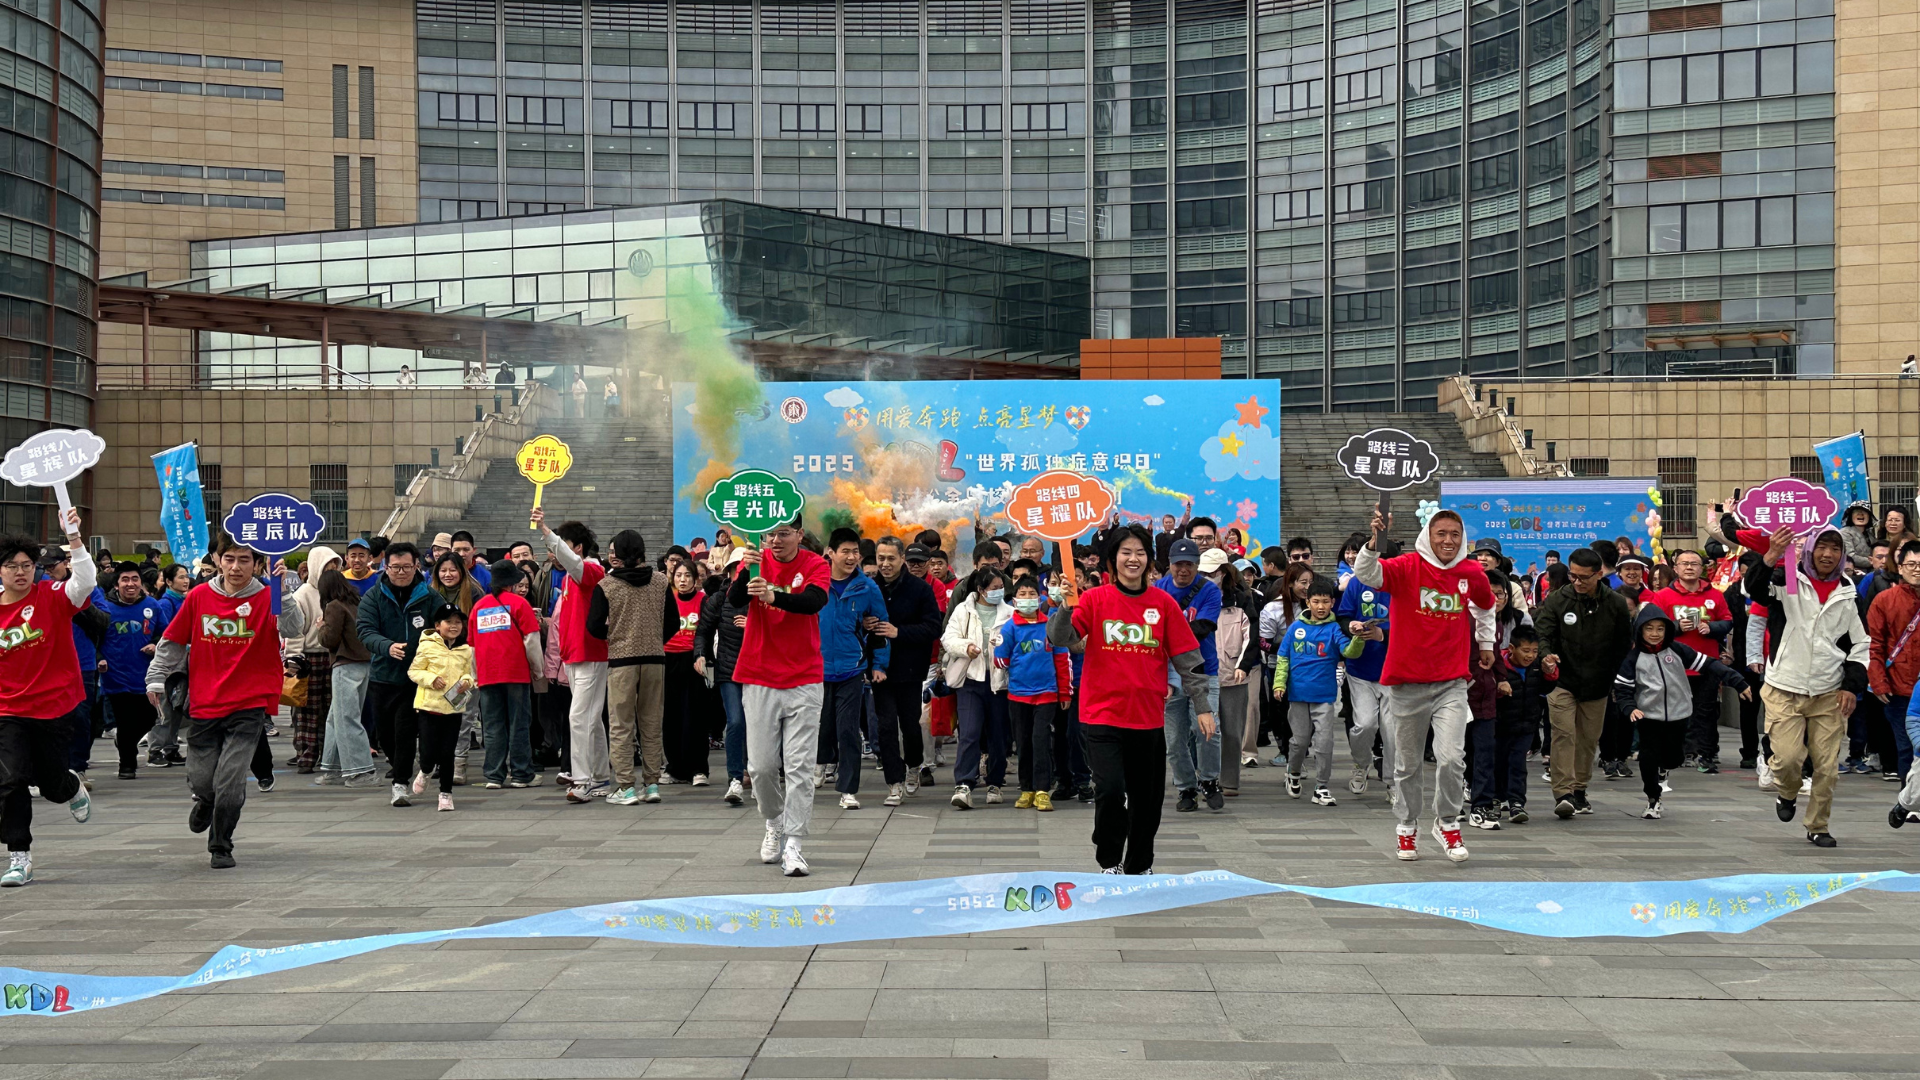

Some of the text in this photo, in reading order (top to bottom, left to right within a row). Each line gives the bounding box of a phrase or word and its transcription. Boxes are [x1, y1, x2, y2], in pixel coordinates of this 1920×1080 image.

[876, 404, 1059, 429] 用爱奔跑 点亮星梦
[28, 439, 71, 458] 路线八
[1368, 441, 1410, 456] 路线三
[20, 448, 88, 479] 星辉队
[525, 458, 559, 473] 星梦队
[793, 455, 854, 473] 2025
[1354, 456, 1420, 478] 星愿队
[734, 484, 775, 497] 路线五
[1036, 485, 1080, 502] 路线四
[1766, 491, 1808, 504] 路线二
[253, 506, 296, 520] 路线七
[723, 500, 787, 518] 星光队
[1027, 501, 1096, 527] 星耀队
[1755, 507, 1820, 524] 星语队
[241, 522, 309, 541] 星辰队
[1419, 586, 1464, 613] KDL
[1361, 603, 1389, 618] KD
[115, 619, 151, 635] KDL
[201, 614, 255, 638] KDL
[1103, 619, 1159, 647] KDL
[1293, 641, 1327, 657] KDL
[4, 983, 74, 1012] KDL
